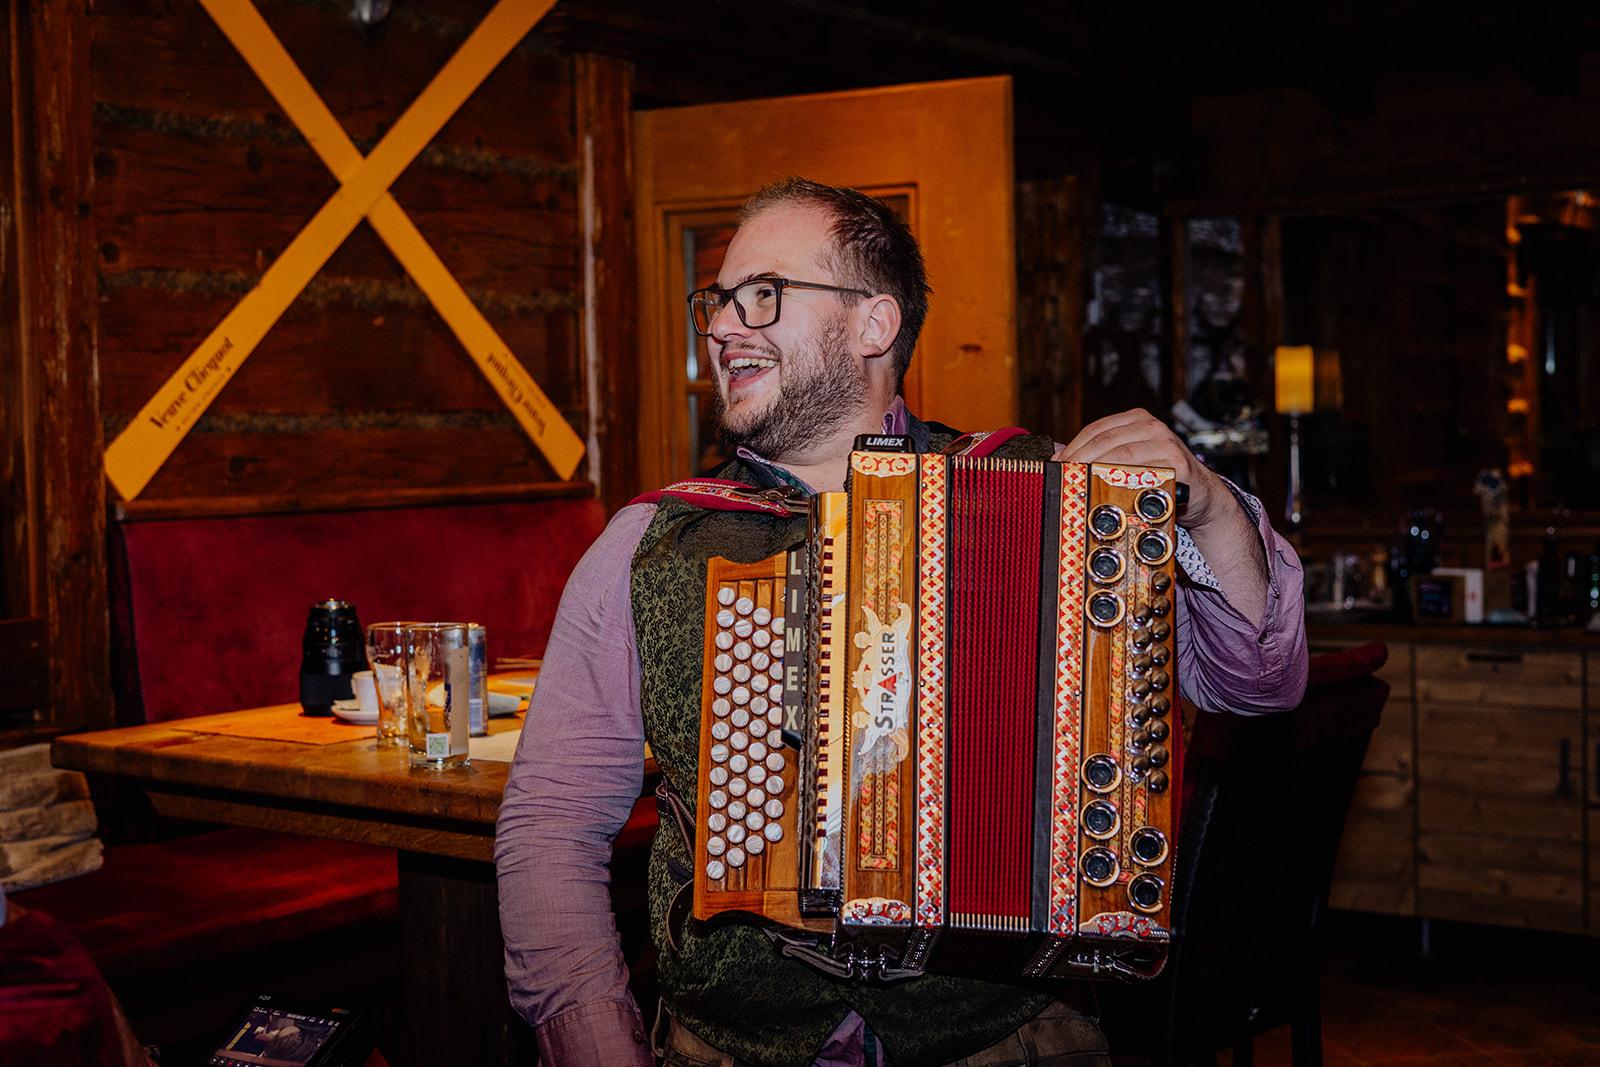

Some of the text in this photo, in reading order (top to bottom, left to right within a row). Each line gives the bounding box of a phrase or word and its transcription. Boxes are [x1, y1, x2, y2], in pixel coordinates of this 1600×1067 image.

[865, 437, 905, 447] LIMEX
[784, 551, 802, 731] LIMEX
[874, 632, 897, 729] STRASSER
